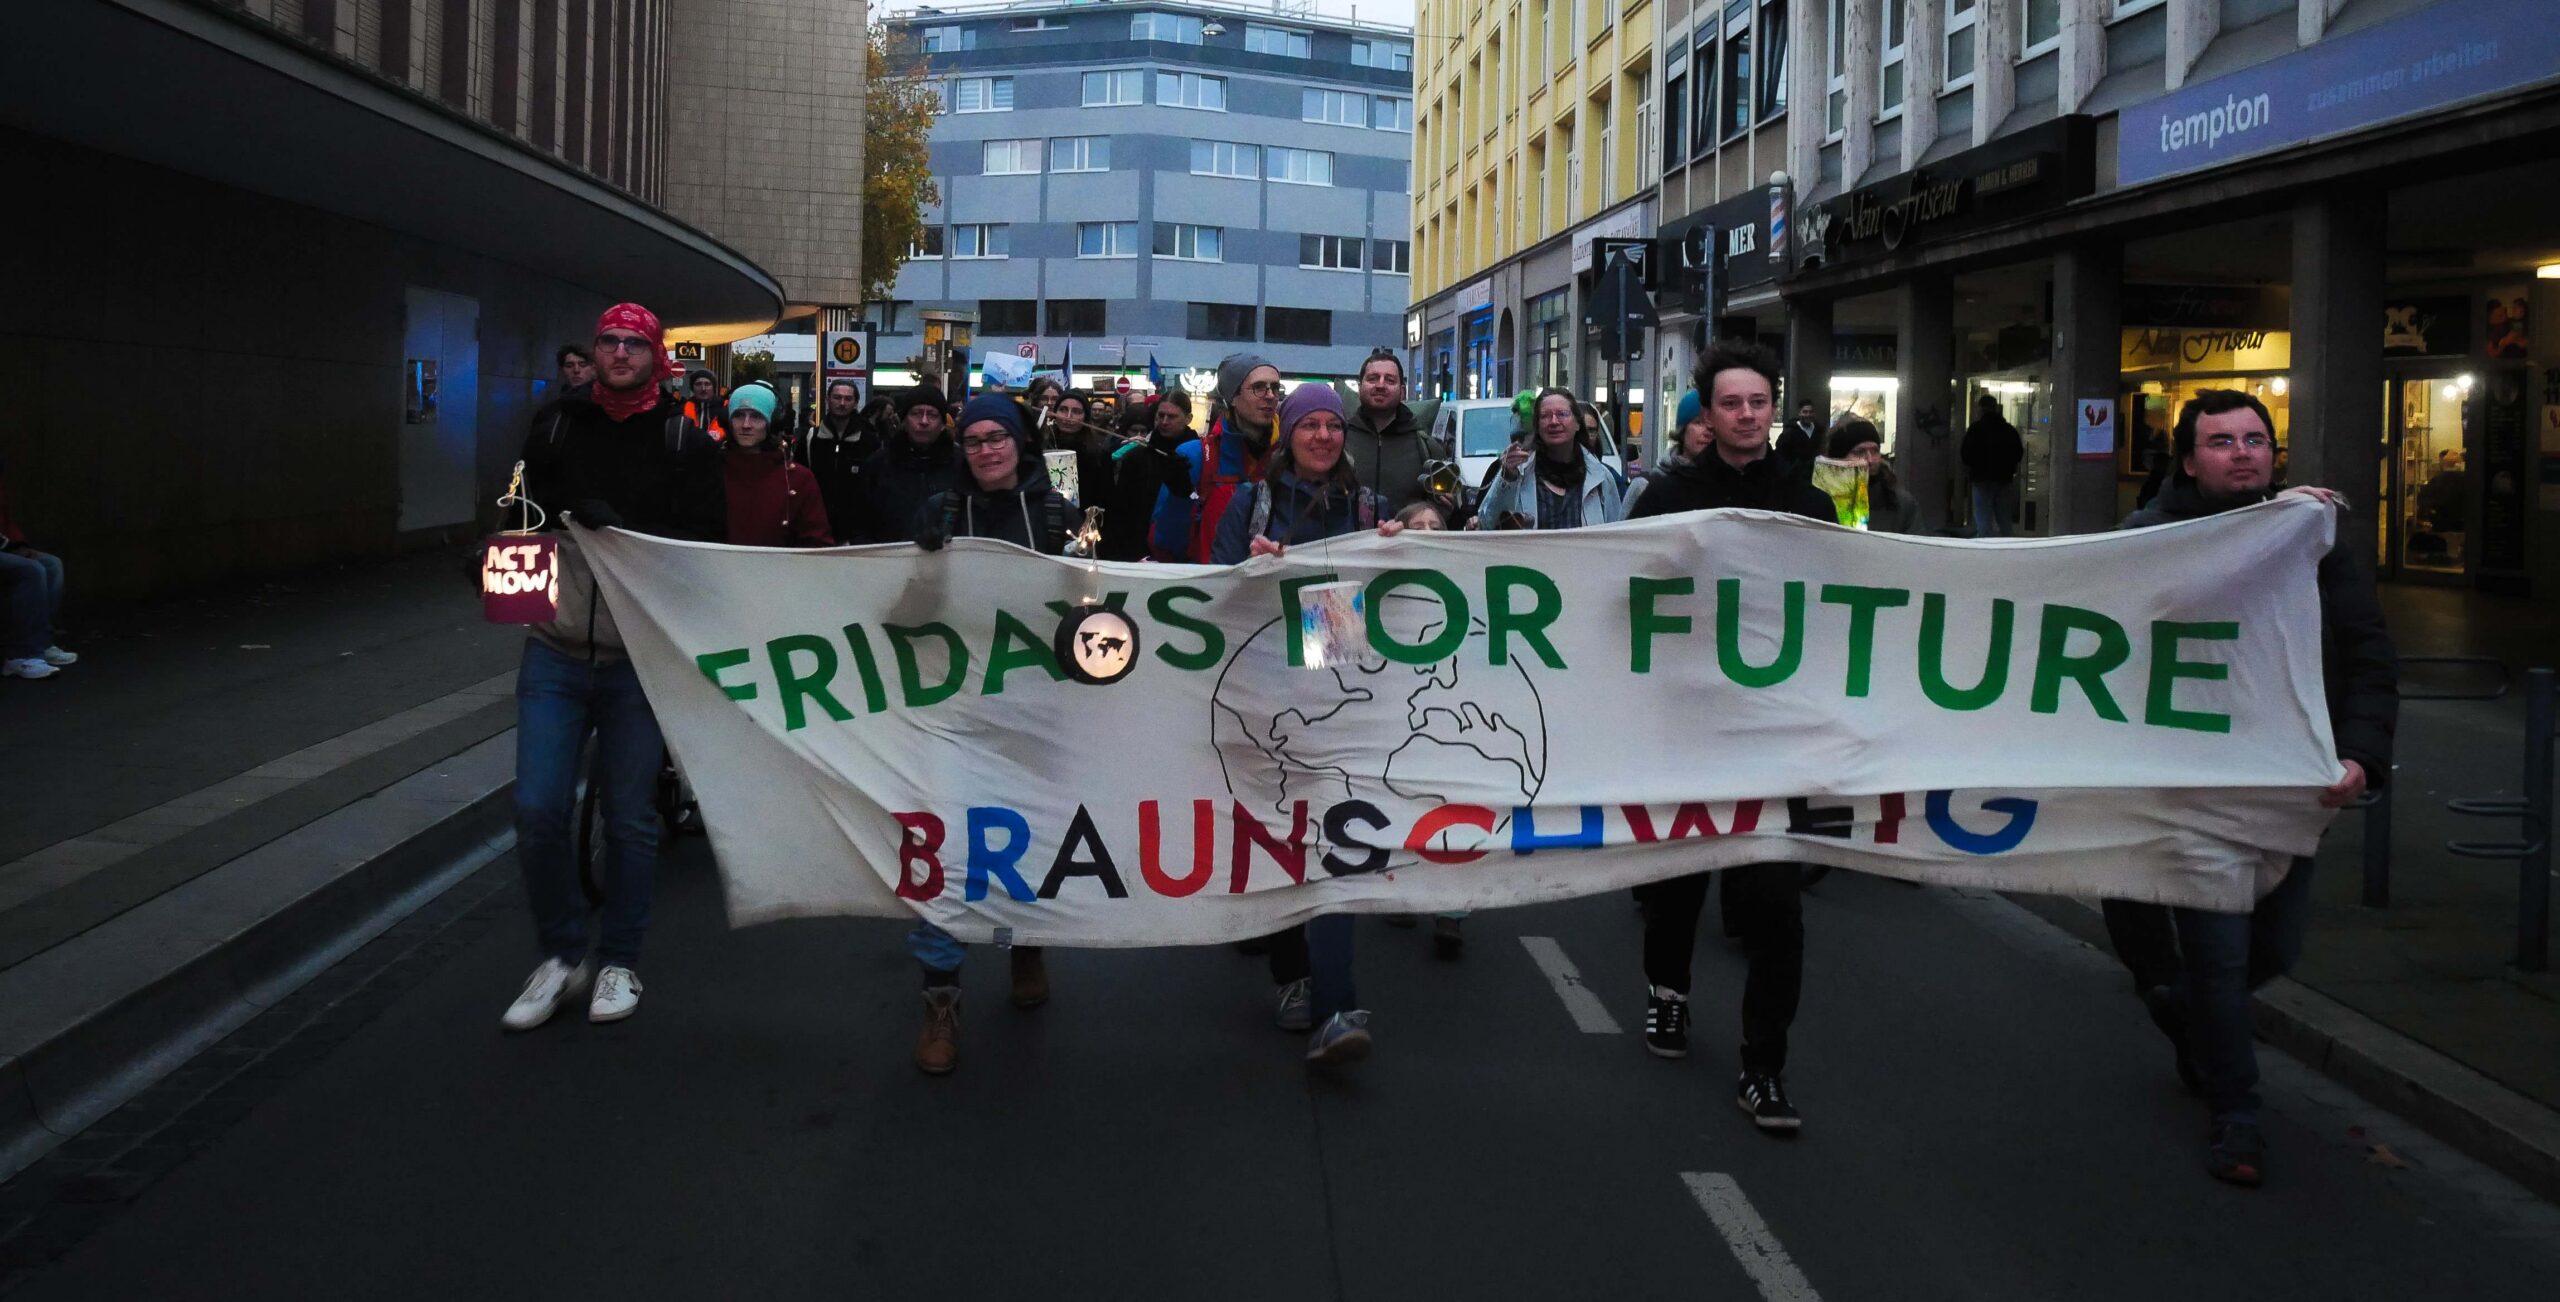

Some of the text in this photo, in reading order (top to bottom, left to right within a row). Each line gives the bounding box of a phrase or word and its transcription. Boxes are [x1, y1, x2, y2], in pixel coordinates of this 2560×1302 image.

[2160, 39, 2499, 152] tempton zusammen arbeiten
[1882, 171, 1965, 252] Friseur
[487, 544, 542, 571] ACT
[487, 569, 549, 595] NOW
[696, 586, 1226, 732] FRIDAS
[1629, 577, 2240, 734] FUTURE
